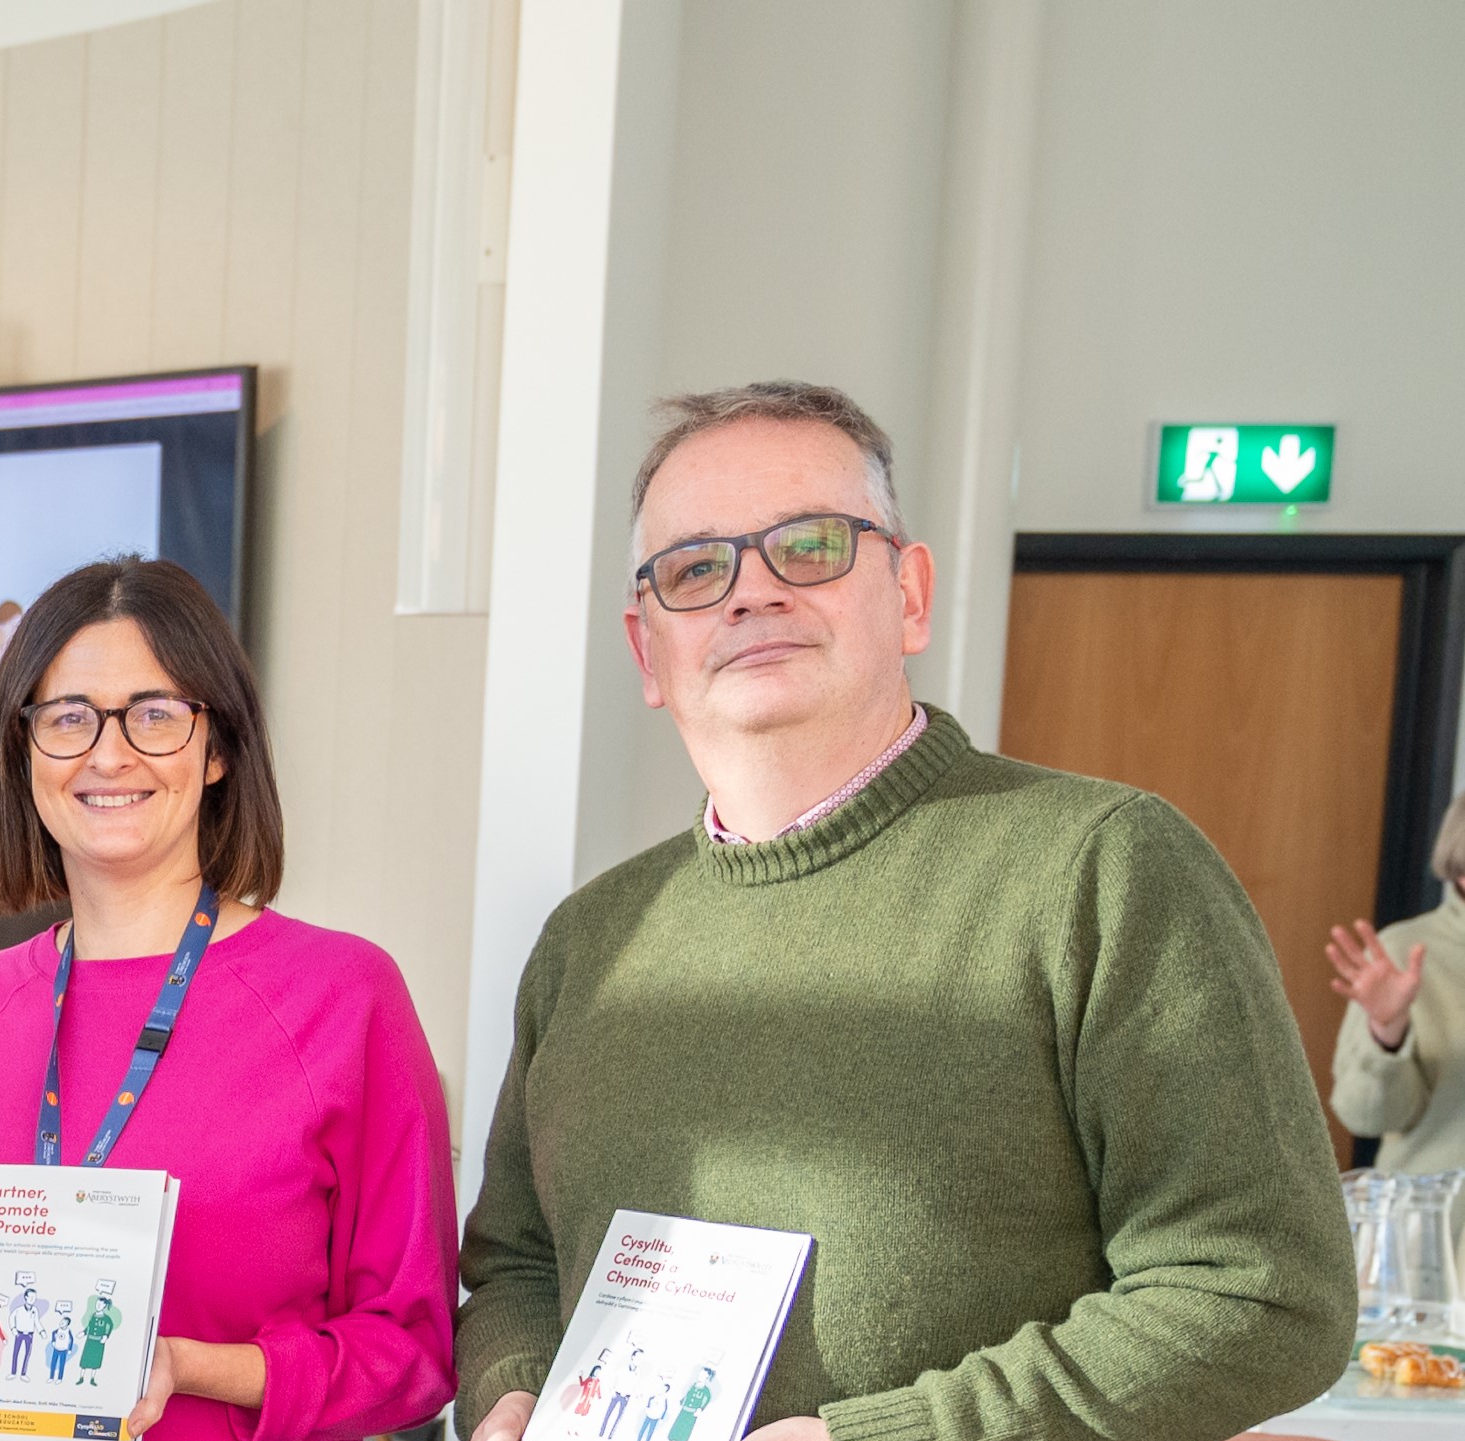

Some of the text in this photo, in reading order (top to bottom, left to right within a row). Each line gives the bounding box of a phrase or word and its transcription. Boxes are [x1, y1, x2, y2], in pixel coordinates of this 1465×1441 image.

[621, 1235, 674, 1255] Cysylltu,
[614, 1253, 678, 1273] Cefnogi a
[606, 1270, 660, 1293] Chynnig
[665, 1281, 736, 1303] Cyfleoedd
